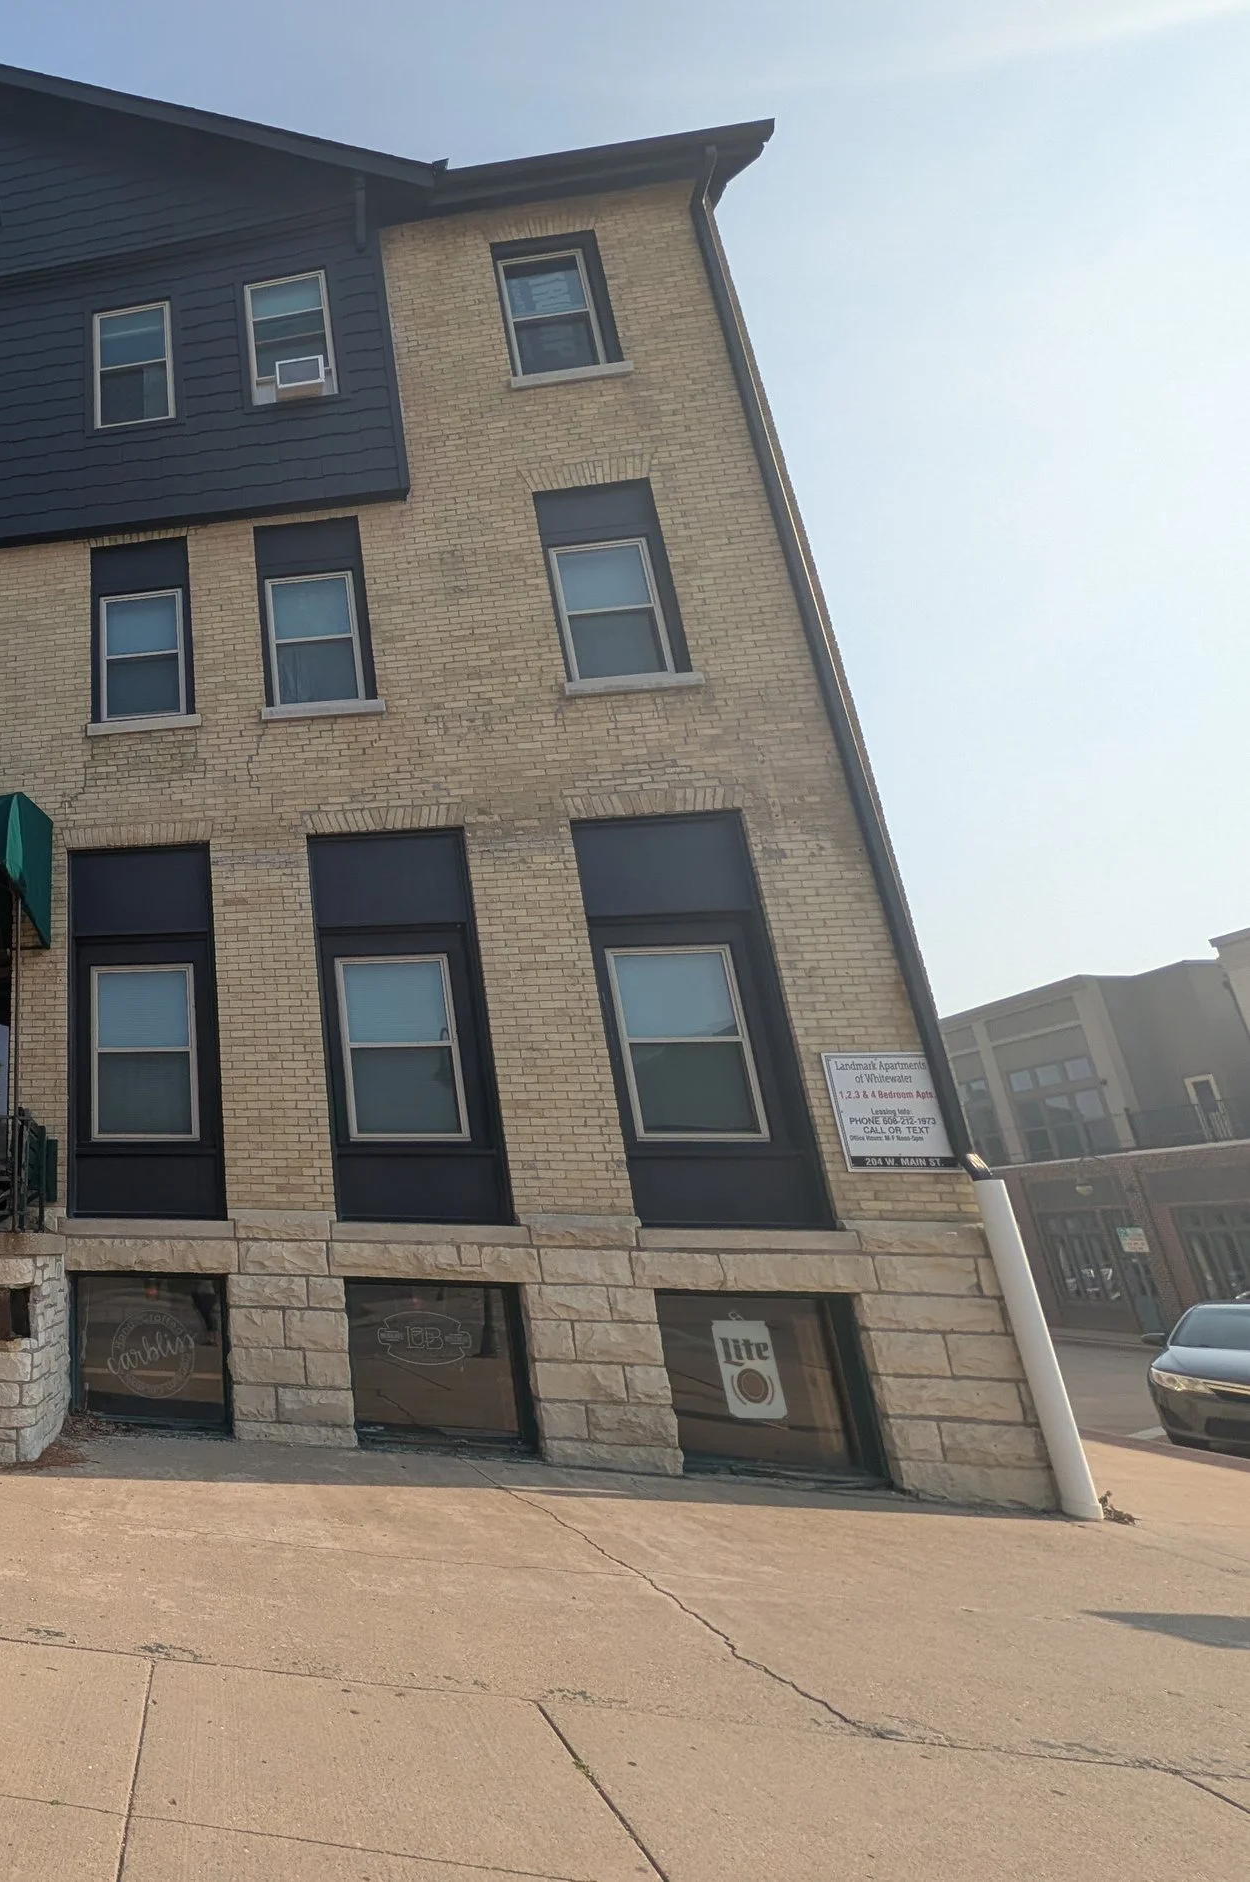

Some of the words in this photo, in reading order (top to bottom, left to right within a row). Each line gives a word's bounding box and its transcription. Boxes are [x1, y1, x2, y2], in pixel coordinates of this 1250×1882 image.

[834, 1061, 877, 1071] Landmark
[879, 1061, 927, 1072] Apartments
[855, 1074, 864, 1083] of
[864, 1074, 912, 1083] Whitewater
[878, 1090, 914, 1098] Bedroom
[871, 1108, 896, 1116] Leasing
[849, 1117, 881, 1125] PHONE
[883, 1117, 936, 1125] 608-212-1973
[863, 1126, 886, 1134] CALL
[888, 1126, 902, 1134] OR
[906, 1126, 930, 1134] TEXT
[865, 1158, 883, 1166] 204
[885, 1158, 898, 1166] W.
[900, 1158, 927, 1166] MAIN
[930, 1158, 944, 1166] ST.
[718, 1337, 770, 1367] Lite
